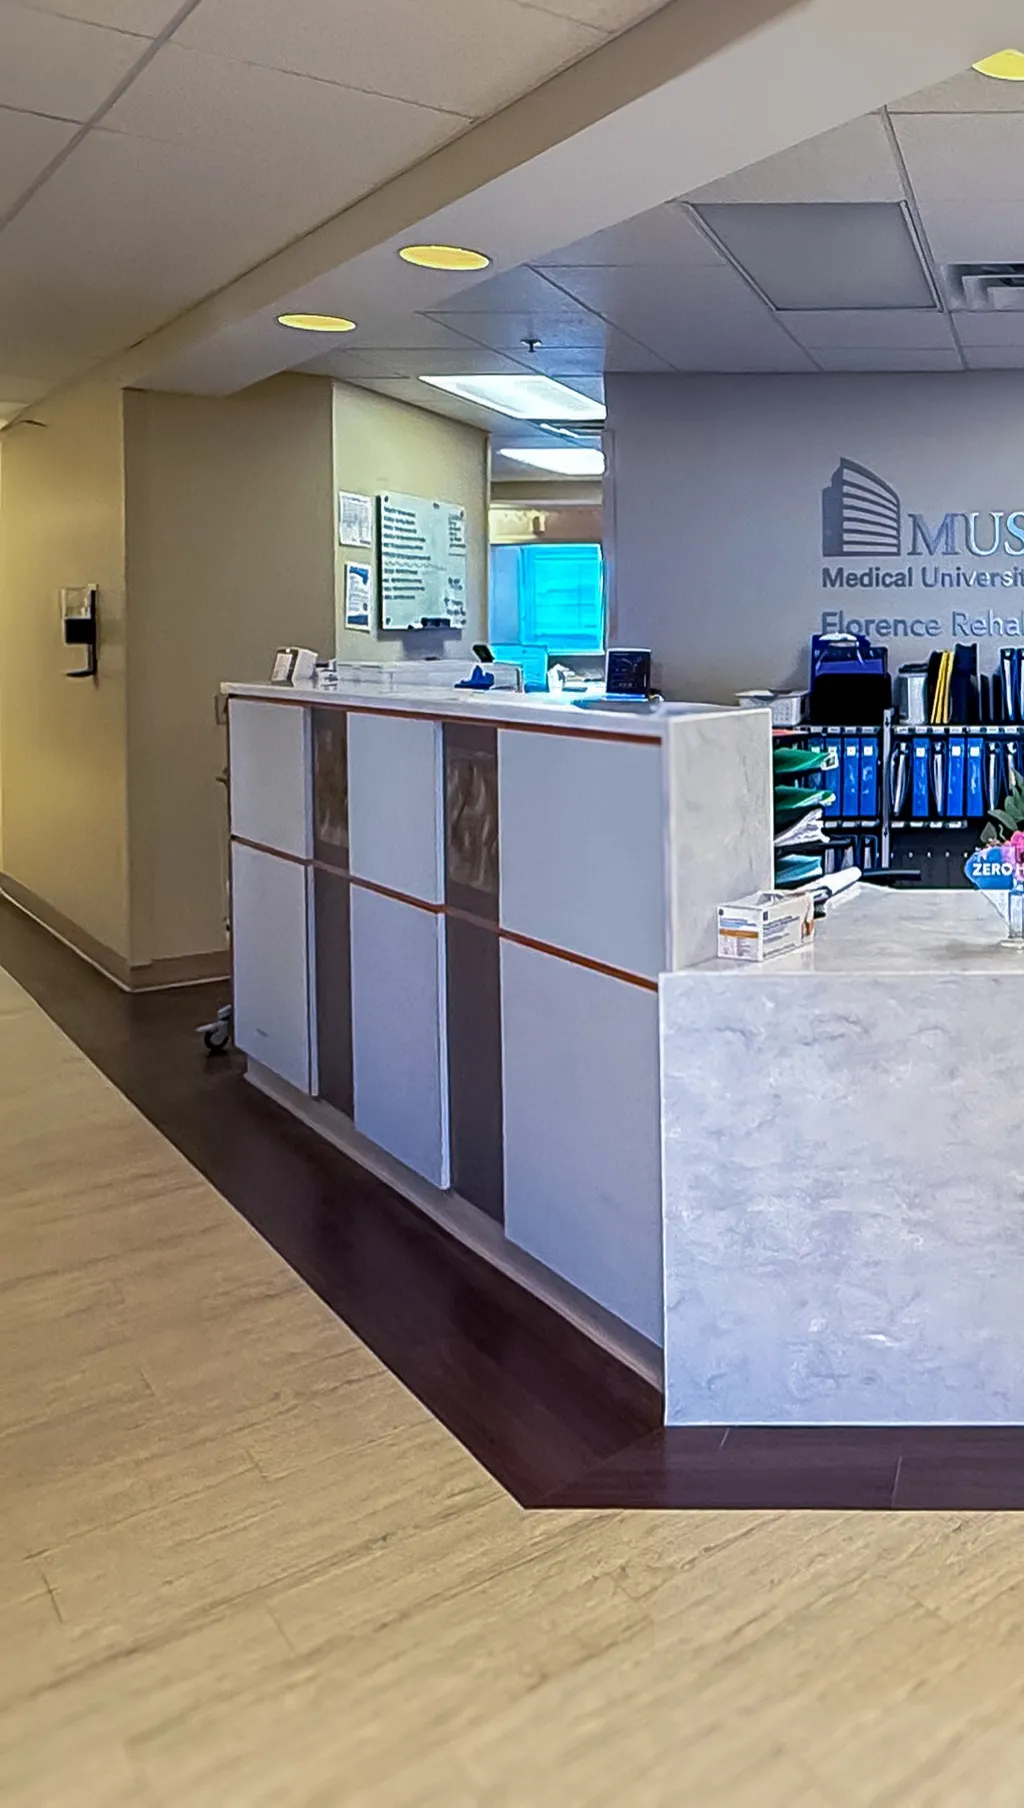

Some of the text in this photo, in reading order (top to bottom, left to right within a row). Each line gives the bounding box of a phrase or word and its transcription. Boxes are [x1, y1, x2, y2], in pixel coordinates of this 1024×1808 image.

[822, 566, 913, 589] Medical
[822, 611, 941, 637] Florence
[972, 862, 1013, 876] ZERO
